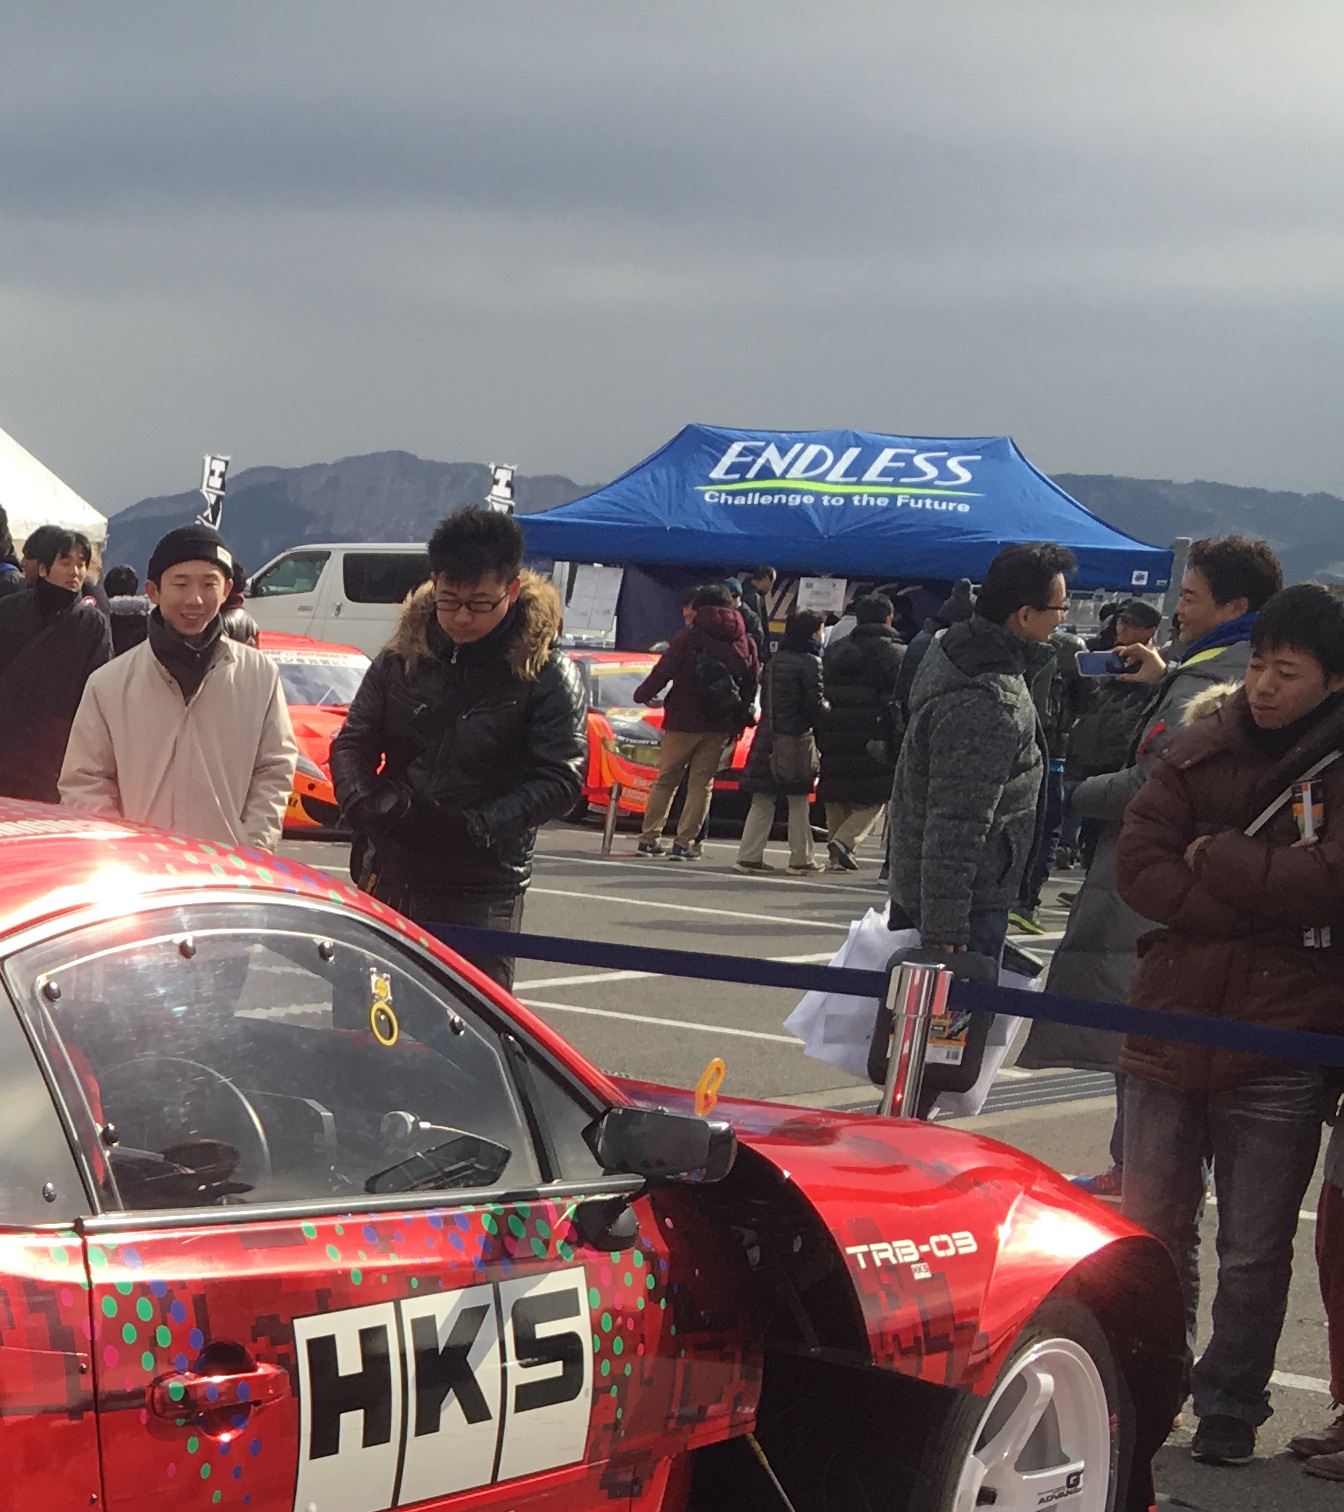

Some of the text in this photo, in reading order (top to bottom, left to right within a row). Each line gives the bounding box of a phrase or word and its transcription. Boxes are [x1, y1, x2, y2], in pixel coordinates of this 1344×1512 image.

[708, 441, 983, 485] ENDLESS
[704, 491, 971, 513] Challenge to the Future
[845, 1230, 979, 1269] TRB-03
[305, 1286, 586, 1461] HKS
